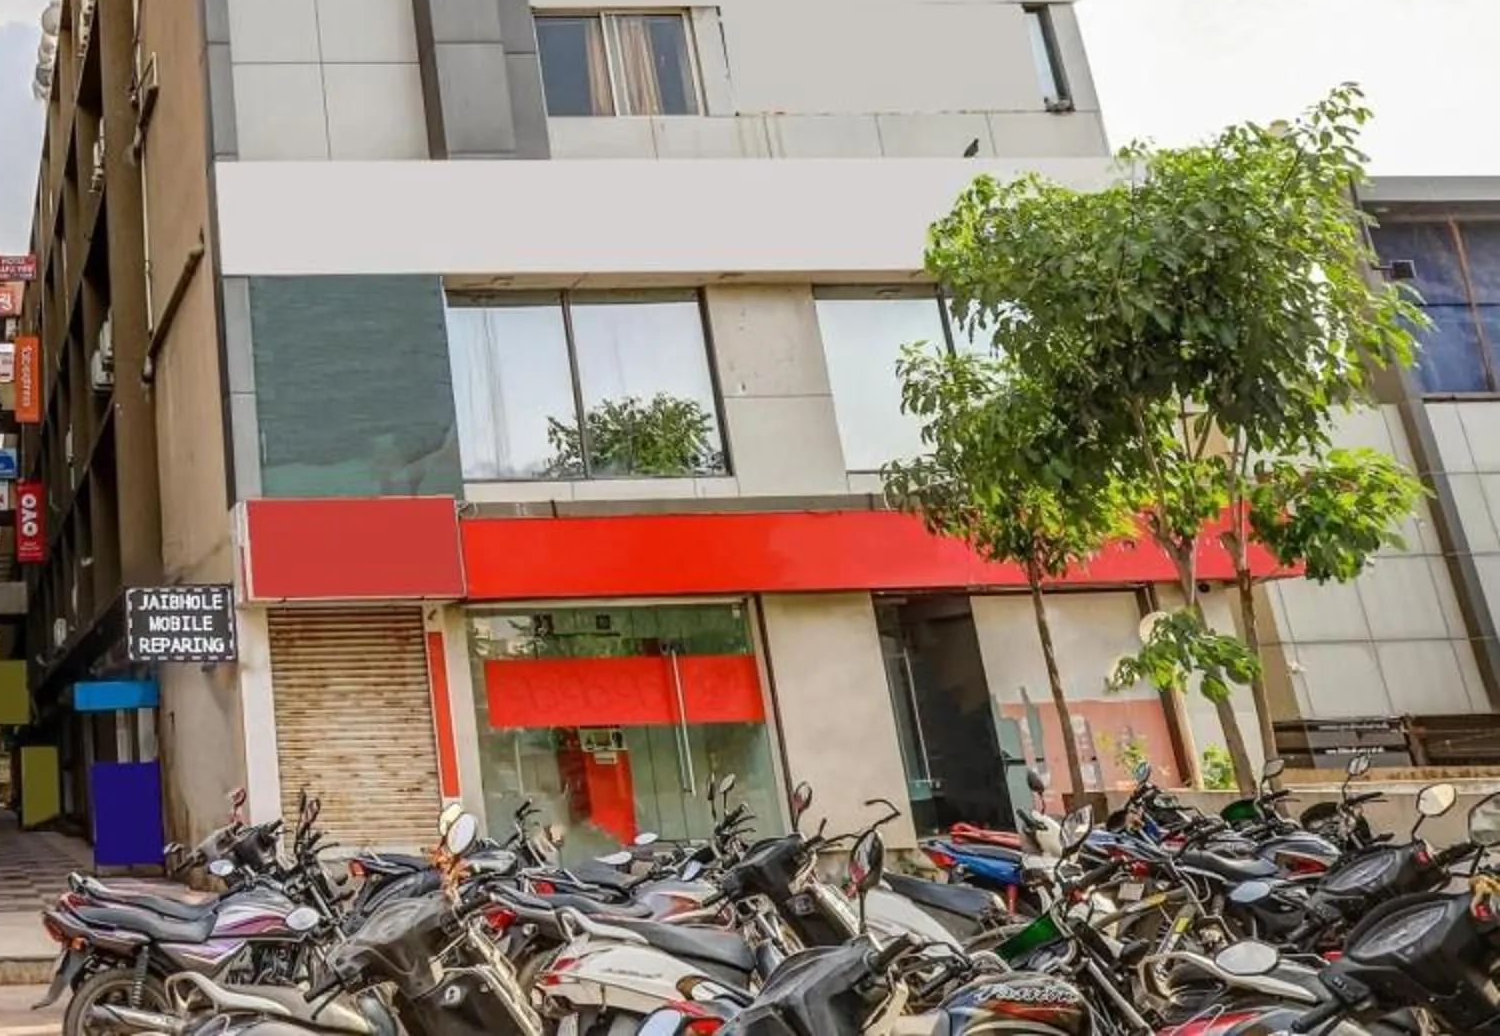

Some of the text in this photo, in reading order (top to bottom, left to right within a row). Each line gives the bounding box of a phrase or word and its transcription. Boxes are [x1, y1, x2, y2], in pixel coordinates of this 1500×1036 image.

[21, 493, 39, 537] OYO
[138, 593, 224, 611] JAIBHOLE
[149, 615, 214, 632] MOBILE
[138, 637, 225, 654] REPARING
